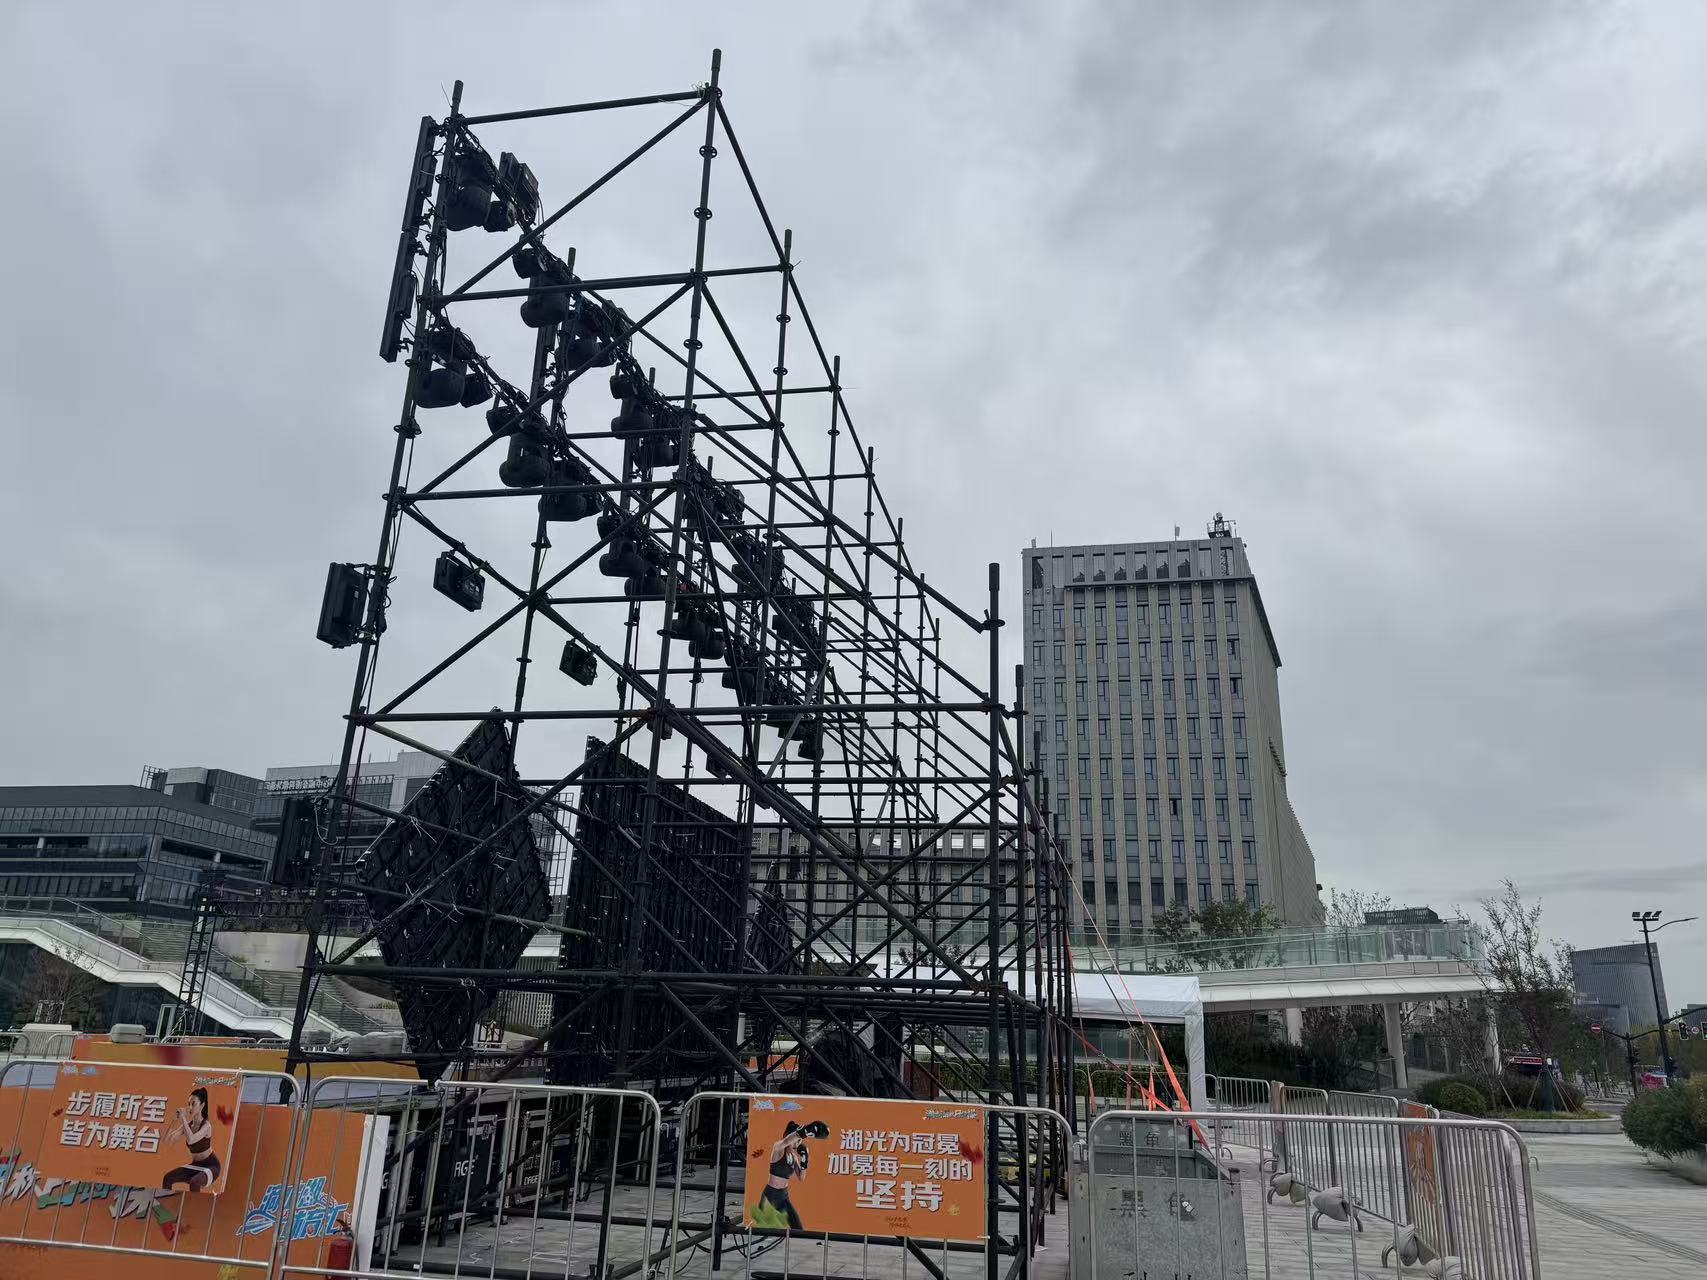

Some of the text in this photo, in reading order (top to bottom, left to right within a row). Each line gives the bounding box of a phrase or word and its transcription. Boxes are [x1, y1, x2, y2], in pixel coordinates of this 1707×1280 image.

[65, 1090, 168, 1122] 步履所至
[60, 1119, 160, 1153] 皆为舞台
[840, 1128, 960, 1155] 湖光为冠冕
[828, 1153, 973, 1182] 加冕每一刻的
[855, 1179, 943, 1212] 坚持
